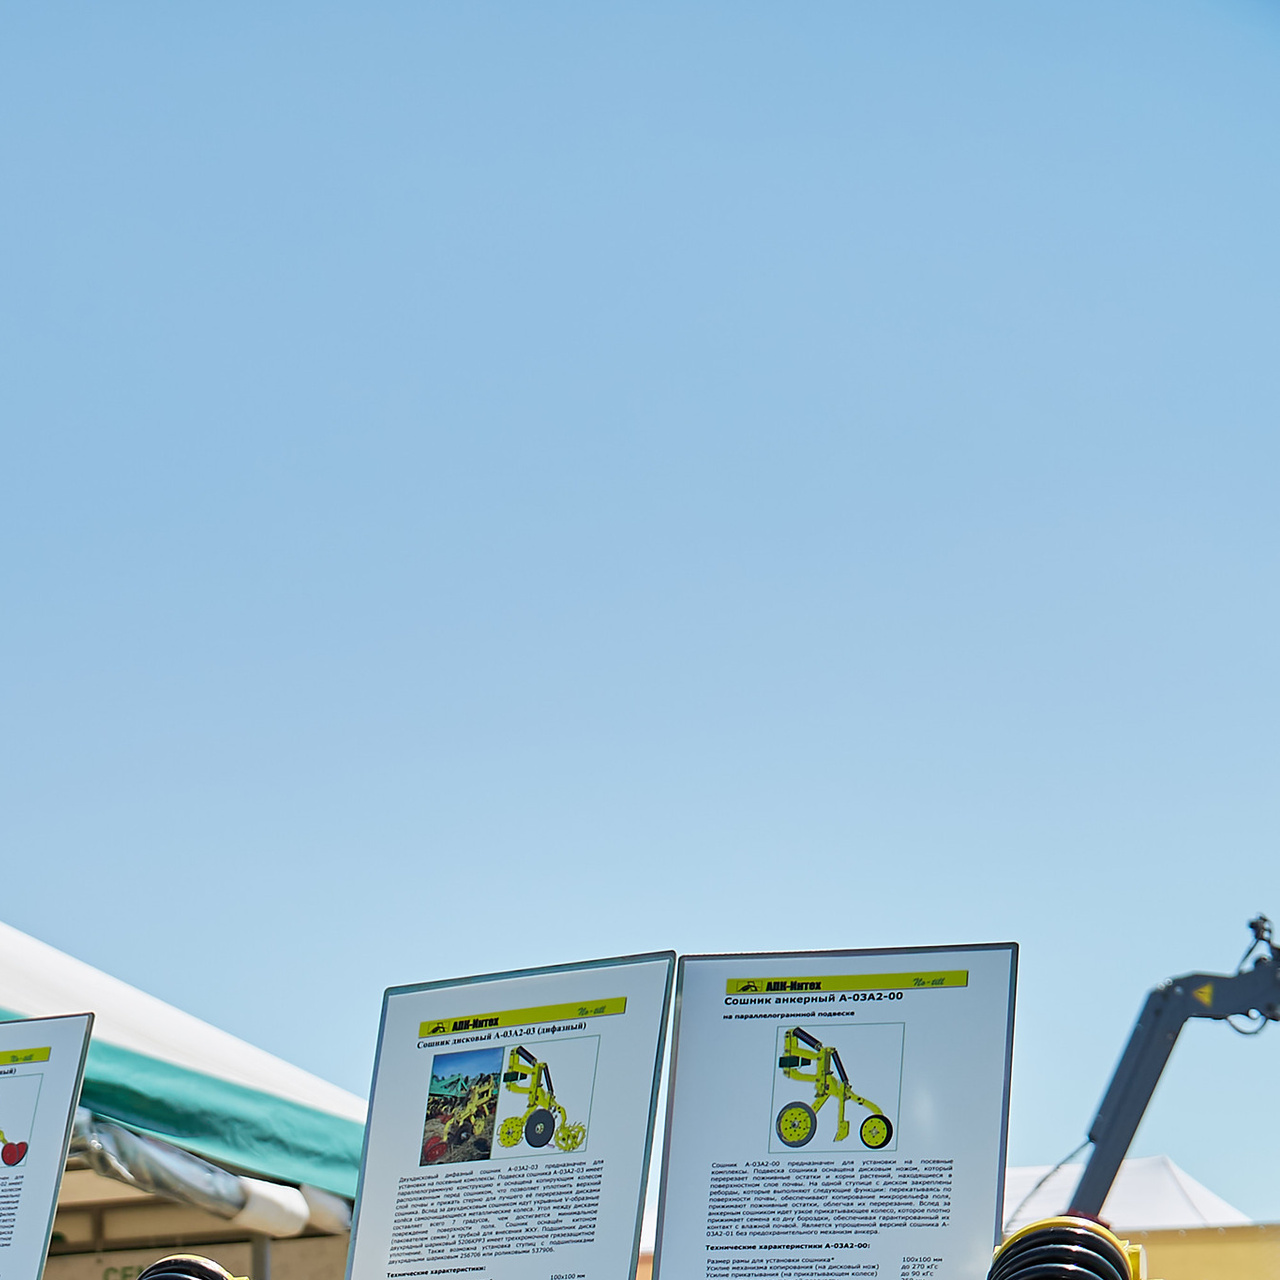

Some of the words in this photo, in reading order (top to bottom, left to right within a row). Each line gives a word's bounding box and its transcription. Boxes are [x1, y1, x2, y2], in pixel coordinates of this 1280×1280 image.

[765, 980, 822, 992] АПК-Интех
[724, 996, 772, 1006] Сошник
[774, 993, 836, 1005] анкерный
[734, 1010, 816, 1021] параллелограммной
[711, 1162, 738, 1170] Сошник
[753, 1167, 785, 1175] Подвеска
[814, 1263, 827, 1271] (на
[827, 1263, 861, 1271] дисковый
[862, 1263, 880, 1271] нож)
[850, 1270, 878, 1278] колесе)
